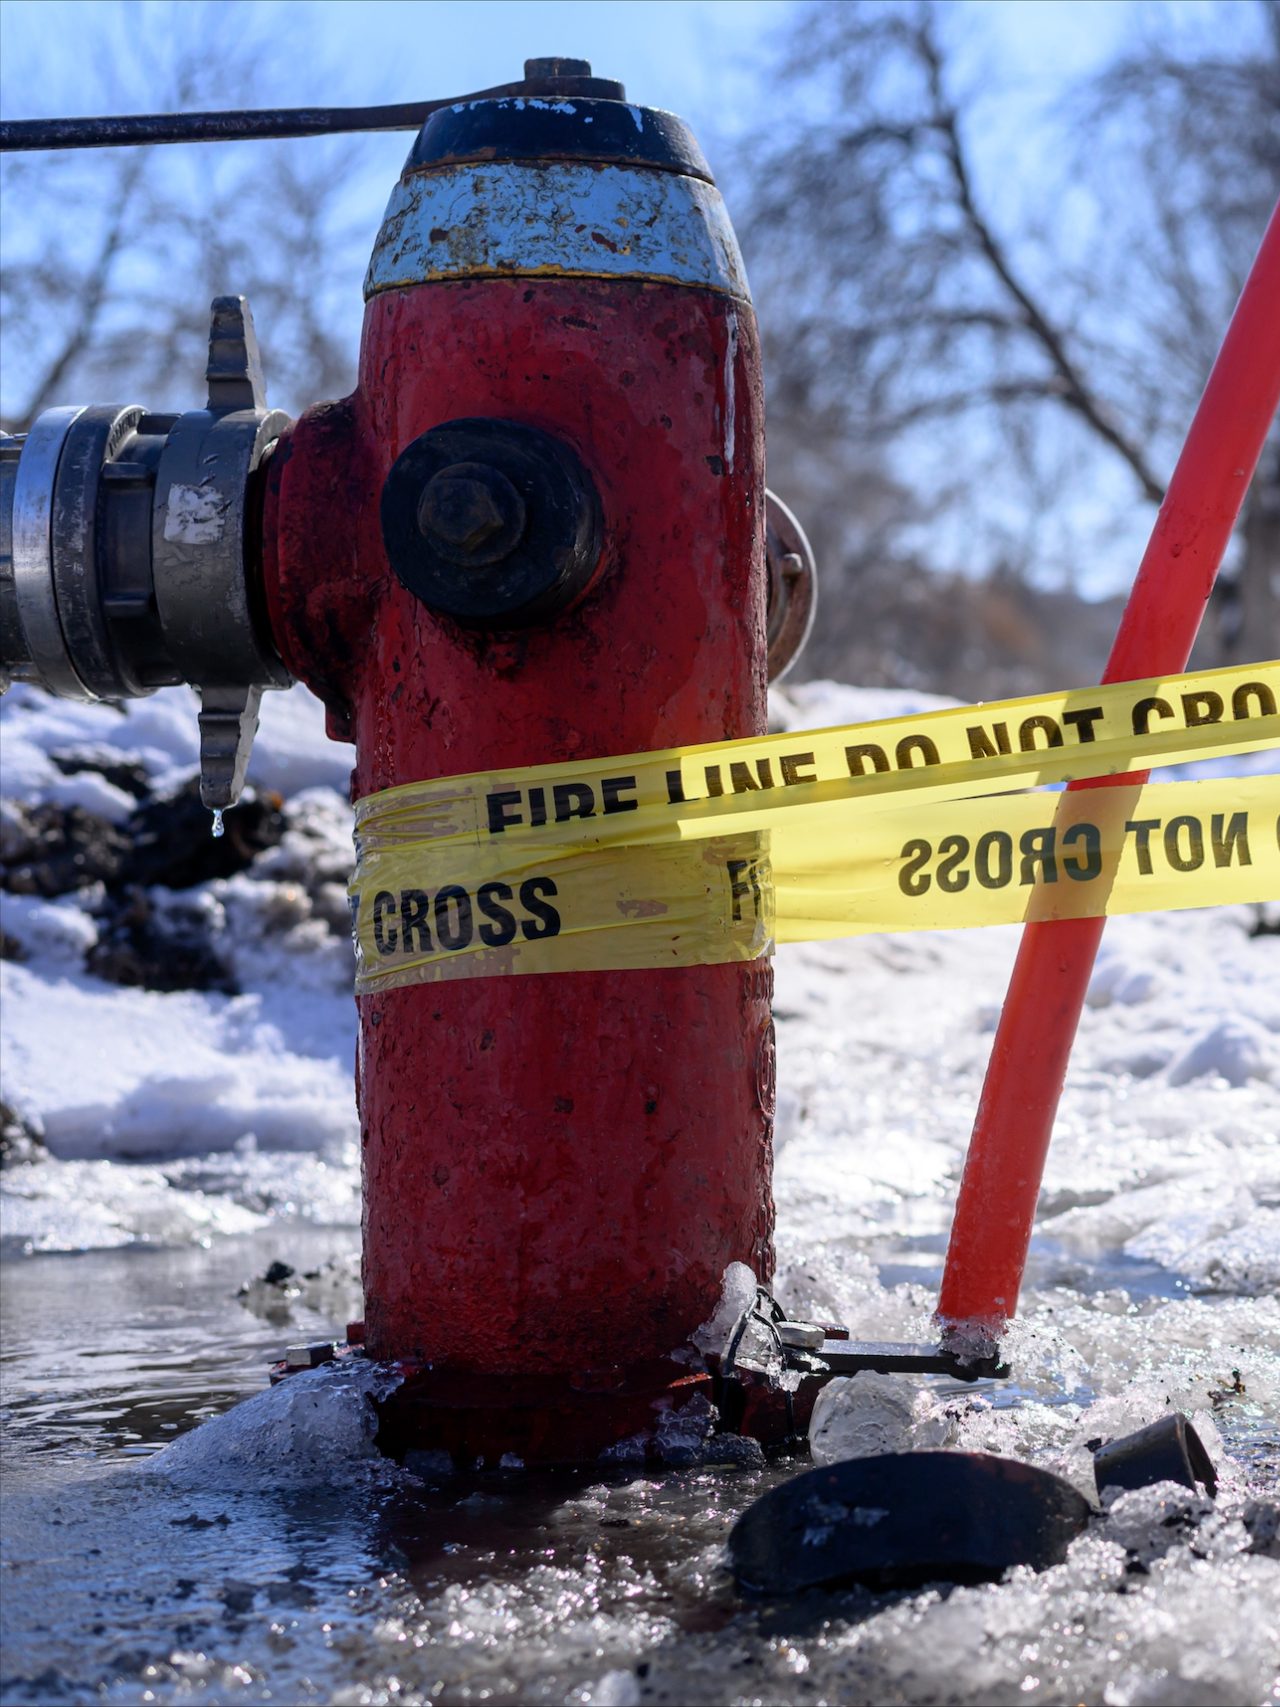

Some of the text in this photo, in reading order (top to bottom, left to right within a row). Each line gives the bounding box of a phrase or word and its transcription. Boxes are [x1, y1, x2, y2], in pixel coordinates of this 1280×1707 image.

[486, 775, 640, 834] FIRE
[664, 752, 819, 805] LINE
[844, 734, 942, 778] DO
[966, 706, 1105, 760] NOT
[372, 876, 562, 957] CROSS
